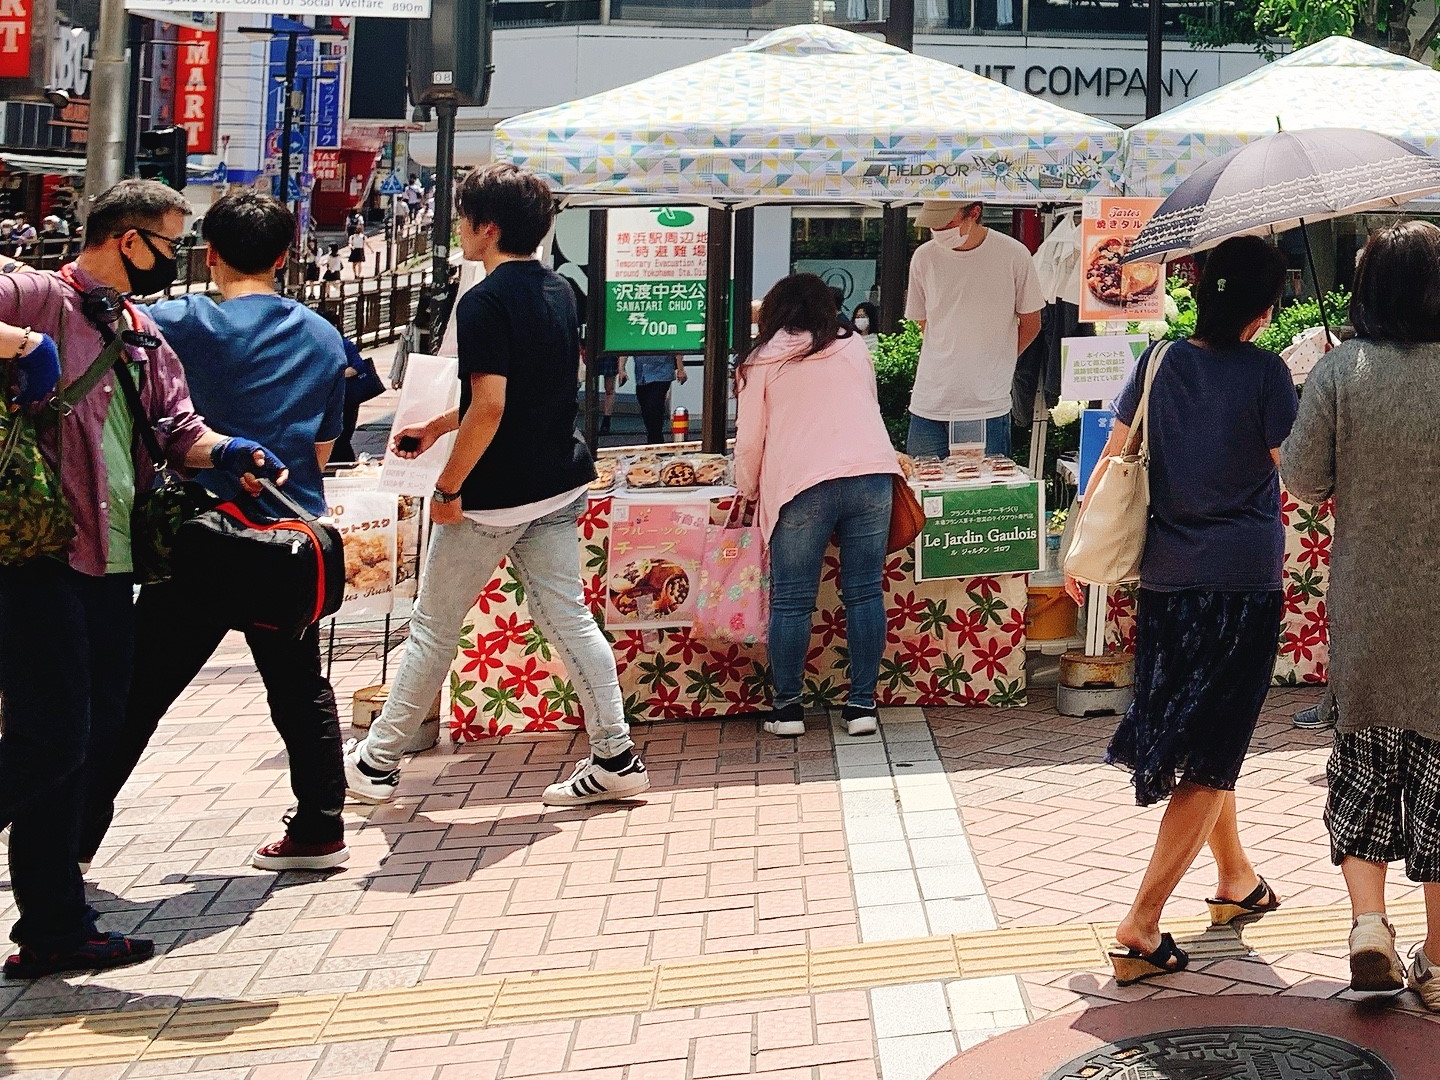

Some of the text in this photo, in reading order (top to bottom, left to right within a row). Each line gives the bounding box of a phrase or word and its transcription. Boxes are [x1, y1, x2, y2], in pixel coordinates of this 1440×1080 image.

[1023, 65, 1199, 98] COMPANY
[886, 163, 970, 178] FIELDOOR
[1108, 206, 1141, 218] Tartes
[616, 259, 652, 268] Temporary
[654, 258, 695, 268] Evacuation
[615, 270, 640, 278] around
[616, 301, 693, 312] SAWATARI CHUO
[640, 321, 678, 336] 700m
[617, 526, 688, 536] フルーツの
[923, 526, 1038, 550] Le Jardin Gaulois
[613, 540, 681, 555] チーズ
